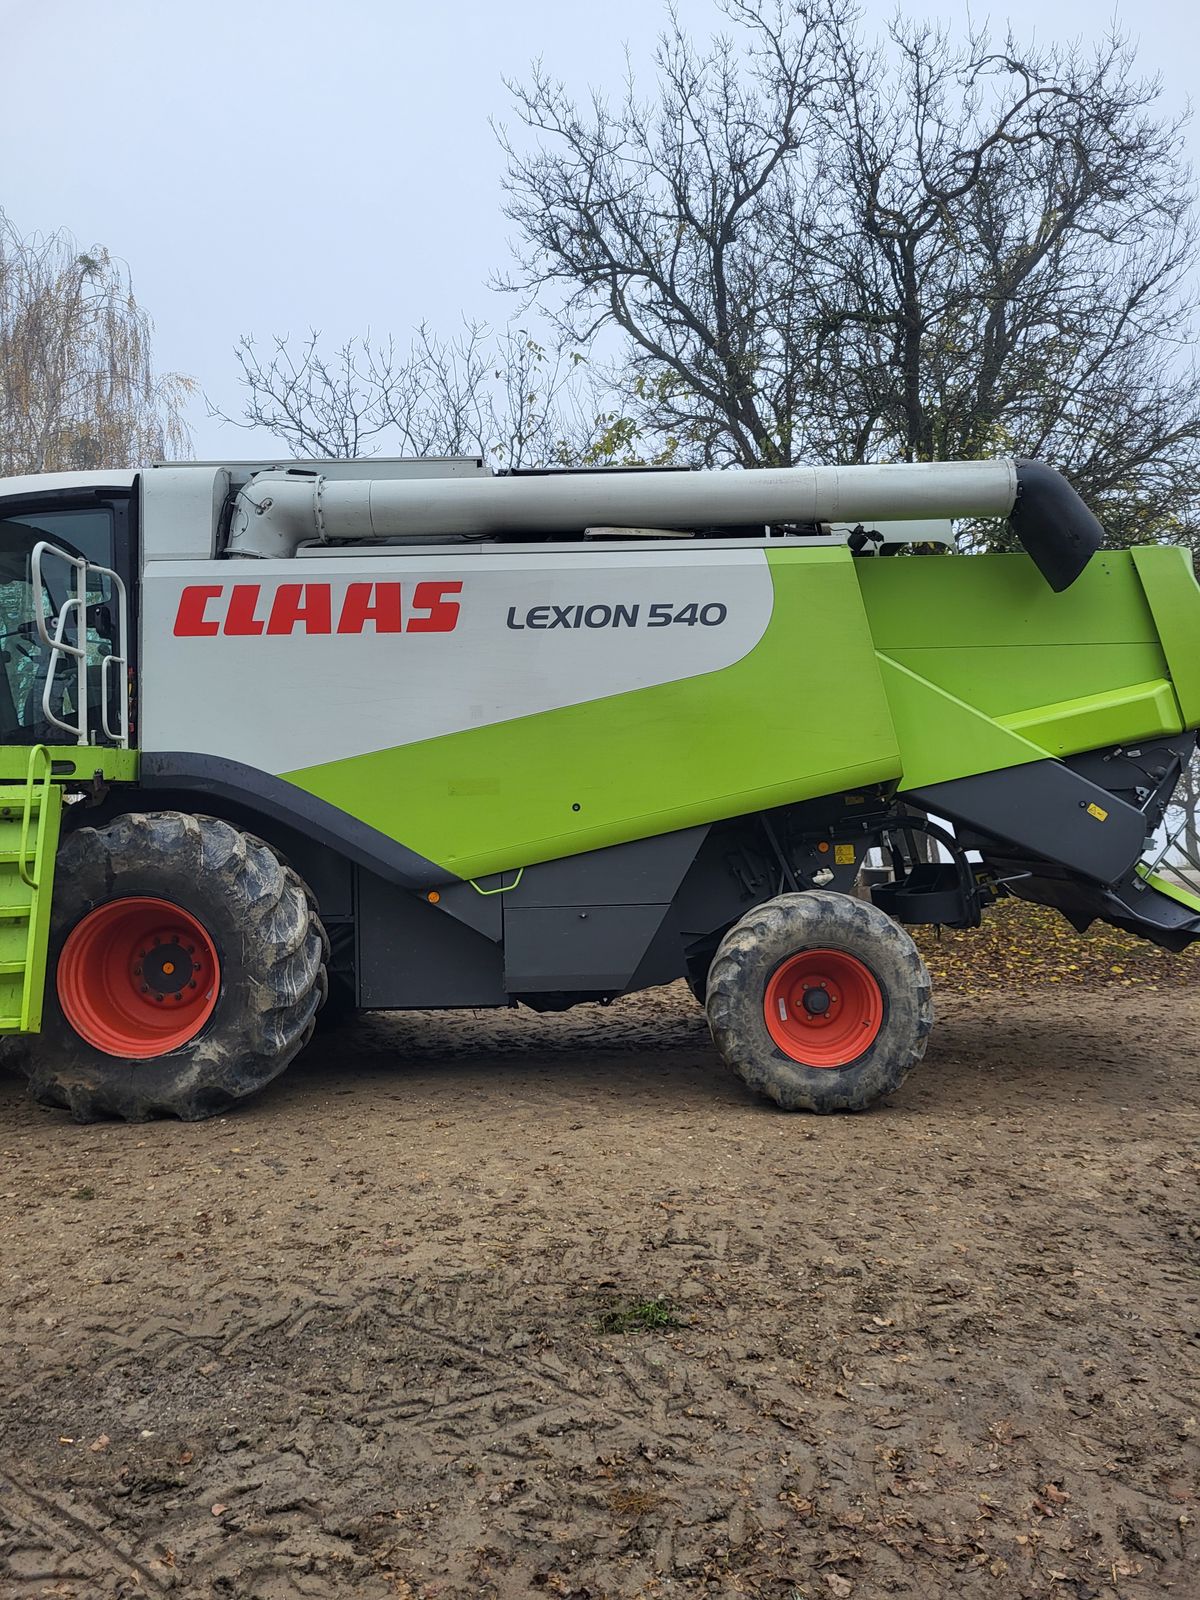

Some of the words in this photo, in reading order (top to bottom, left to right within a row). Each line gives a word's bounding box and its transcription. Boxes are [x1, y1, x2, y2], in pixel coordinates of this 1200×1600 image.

[173, 581, 463, 636] CLAAS
[506, 604, 640, 630] LEXION
[647, 602, 728, 628] 540
